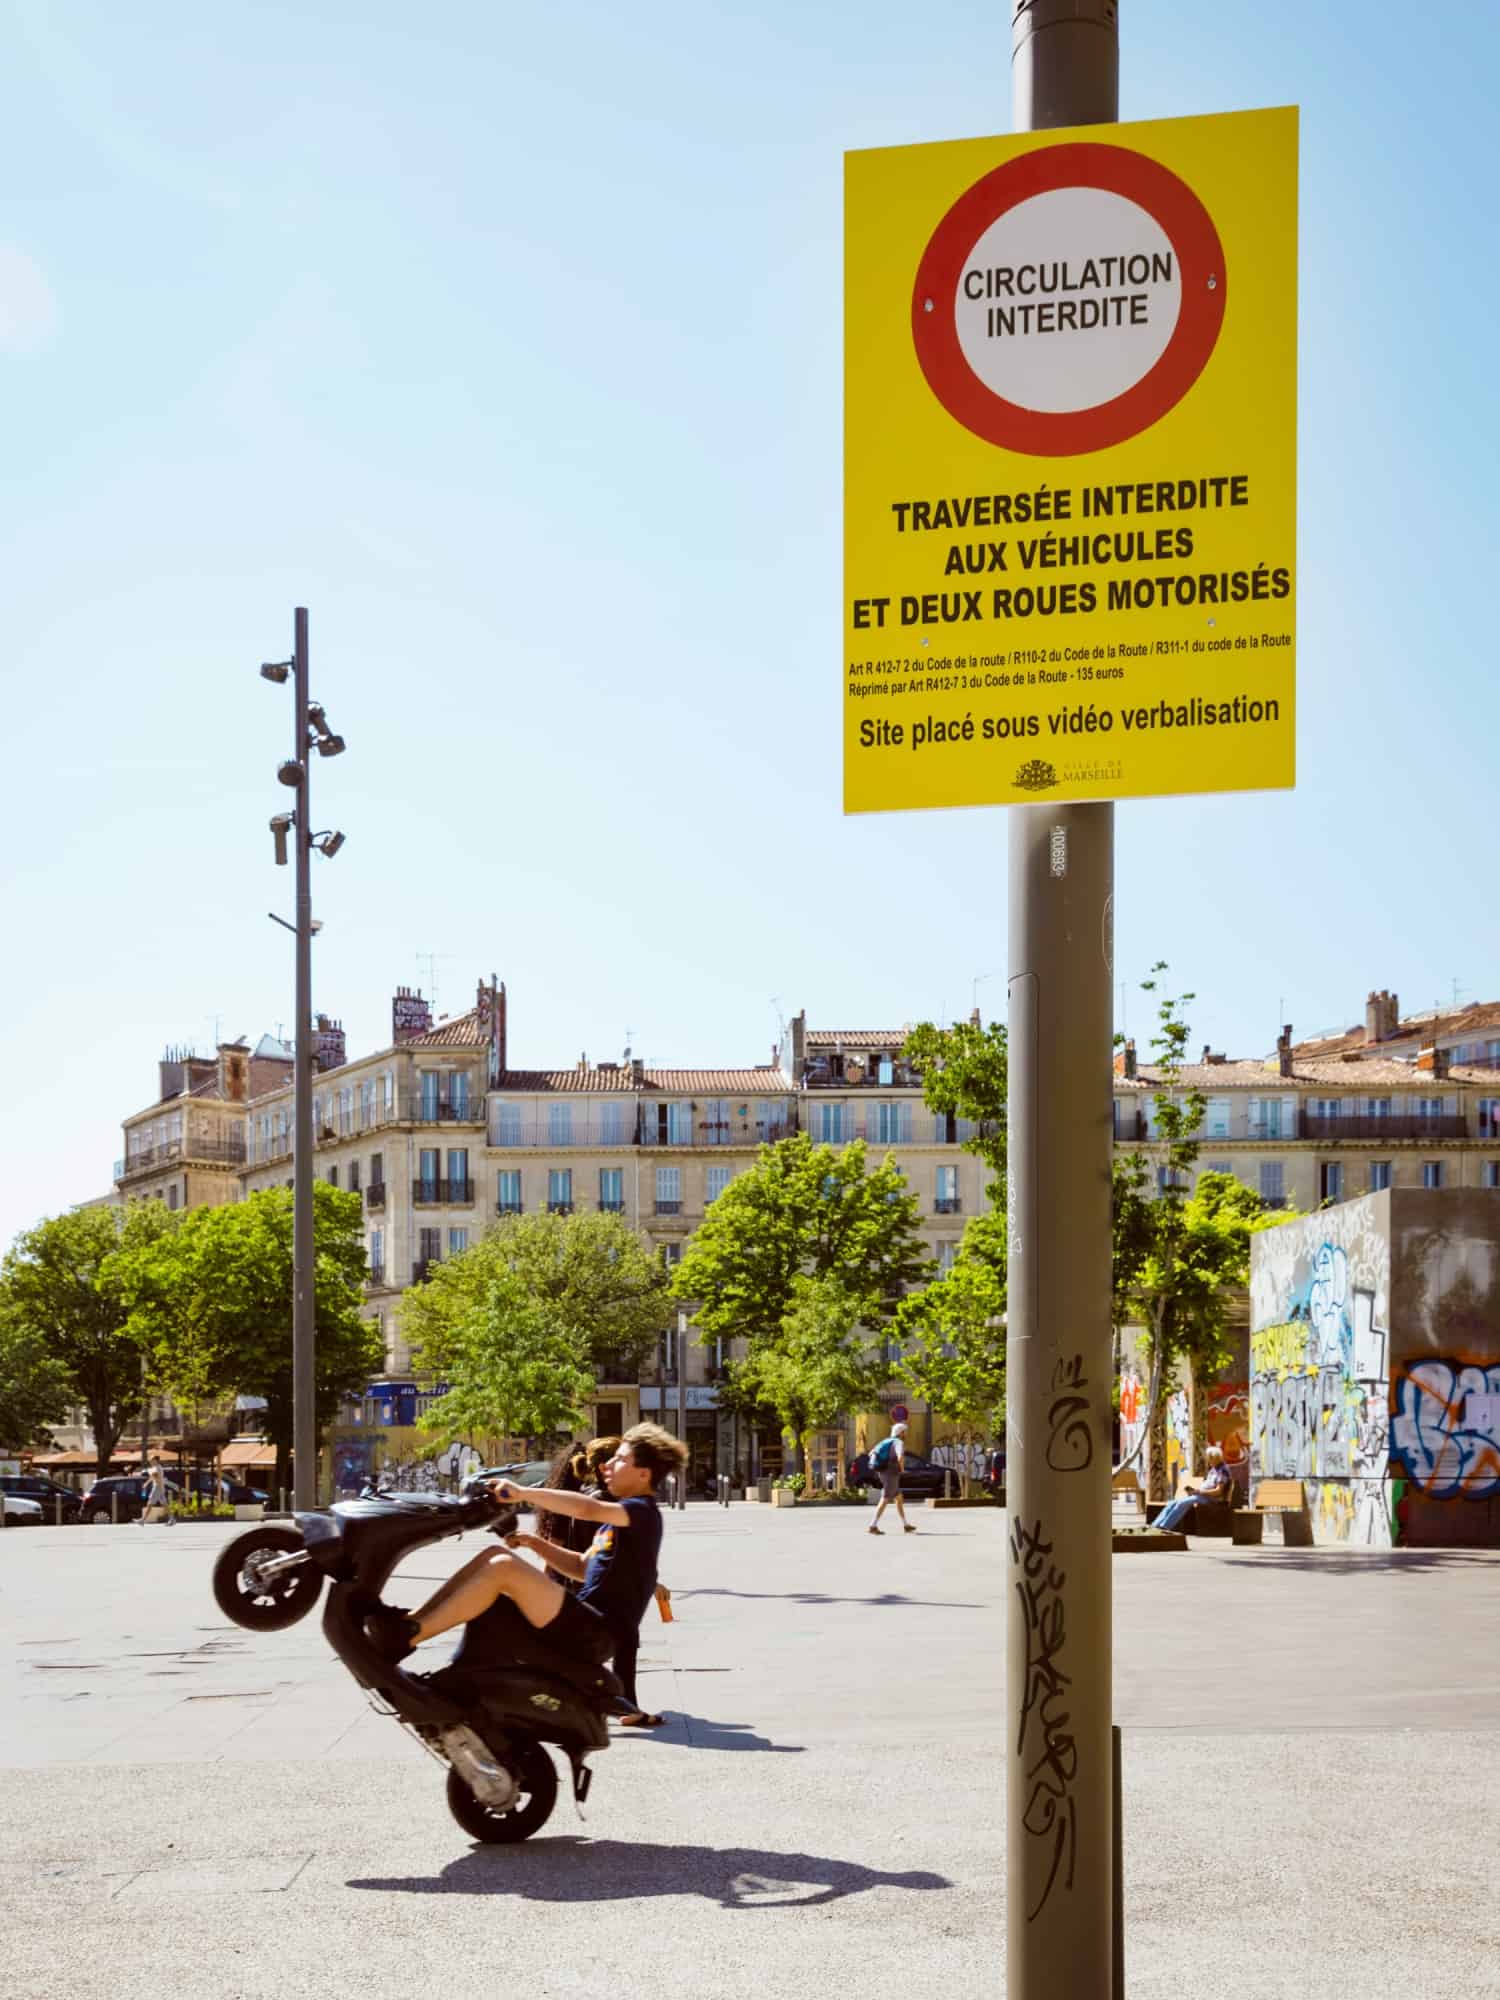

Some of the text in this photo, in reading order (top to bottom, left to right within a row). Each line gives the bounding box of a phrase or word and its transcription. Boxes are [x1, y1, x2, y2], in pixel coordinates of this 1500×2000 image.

[965, 252, 1171, 300] CIRCULATION
[987, 293, 1147, 337] INTERDITE
[892, 476, 1248, 532] TRAVERSÉE INTERDITE
[945, 528, 1193, 575] AUX VÉHICULES
[854, 562, 1290, 628] ET DEUX ROUES MOTORISÉS
[848, 663, 864, 676] Art
[865, 661, 874, 675] R
[875, 659, 901, 674] 412-7
[903, 658, 910, 673] 2
[911, 659, 925, 672] du
[926, 656, 953, 671] Code
[954, 655, 967, 669] de
[968, 655, 978, 668] la
[979, 654, 1006, 667] route
[1013, 649, 1047, 665] R110-2
[1049, 649, 1063, 662] du
[1063, 647, 1090, 662] Code
[1092, 646, 1105, 660] de
[1107, 645, 1116, 659] la
[1118, 643, 1148, 657] Route
[1156, 639, 1189, 655] R311-1
[1191, 639, 1205, 653] du
[1207, 637, 1233, 652] code
[1234, 636, 1247, 650] de
[1249, 635, 1259, 649] la
[1260, 633, 1292, 647] Route
[848, 681, 889, 699] Réprimé
[891, 682, 907, 697] par
[908, 679, 924, 692] Art
[926, 676, 959, 692] R412-7
[961, 675, 967, 689] 3
[969, 675, 983, 689] du
[984, 673, 1011, 688] Code
[1012, 671, 1025, 686] de
[1027, 671, 1036, 685] la
[1038, 669, 1068, 683] Route
[1076, 666, 1094, 681] 135
[1095, 667, 1124, 680] euros
[860, 695, 1278, 750] Site placé sous vidéo verbalisation
